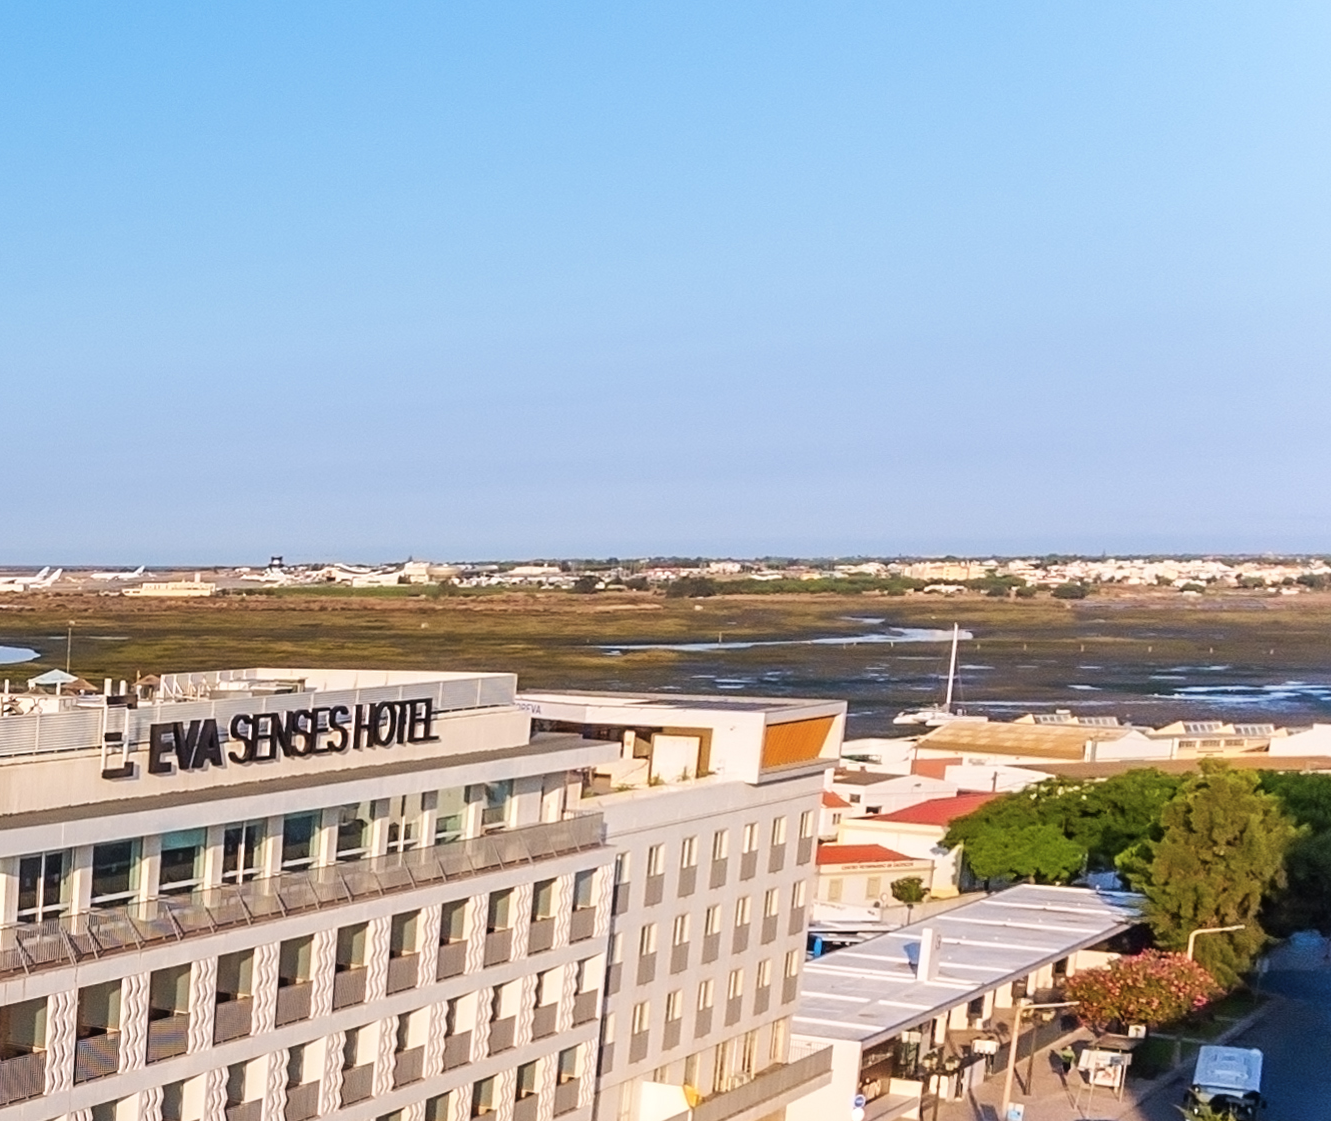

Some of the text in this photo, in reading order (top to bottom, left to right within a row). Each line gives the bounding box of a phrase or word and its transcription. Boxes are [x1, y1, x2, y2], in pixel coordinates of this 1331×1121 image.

[147, 697, 440, 774] EVA SENSES HOTEL
